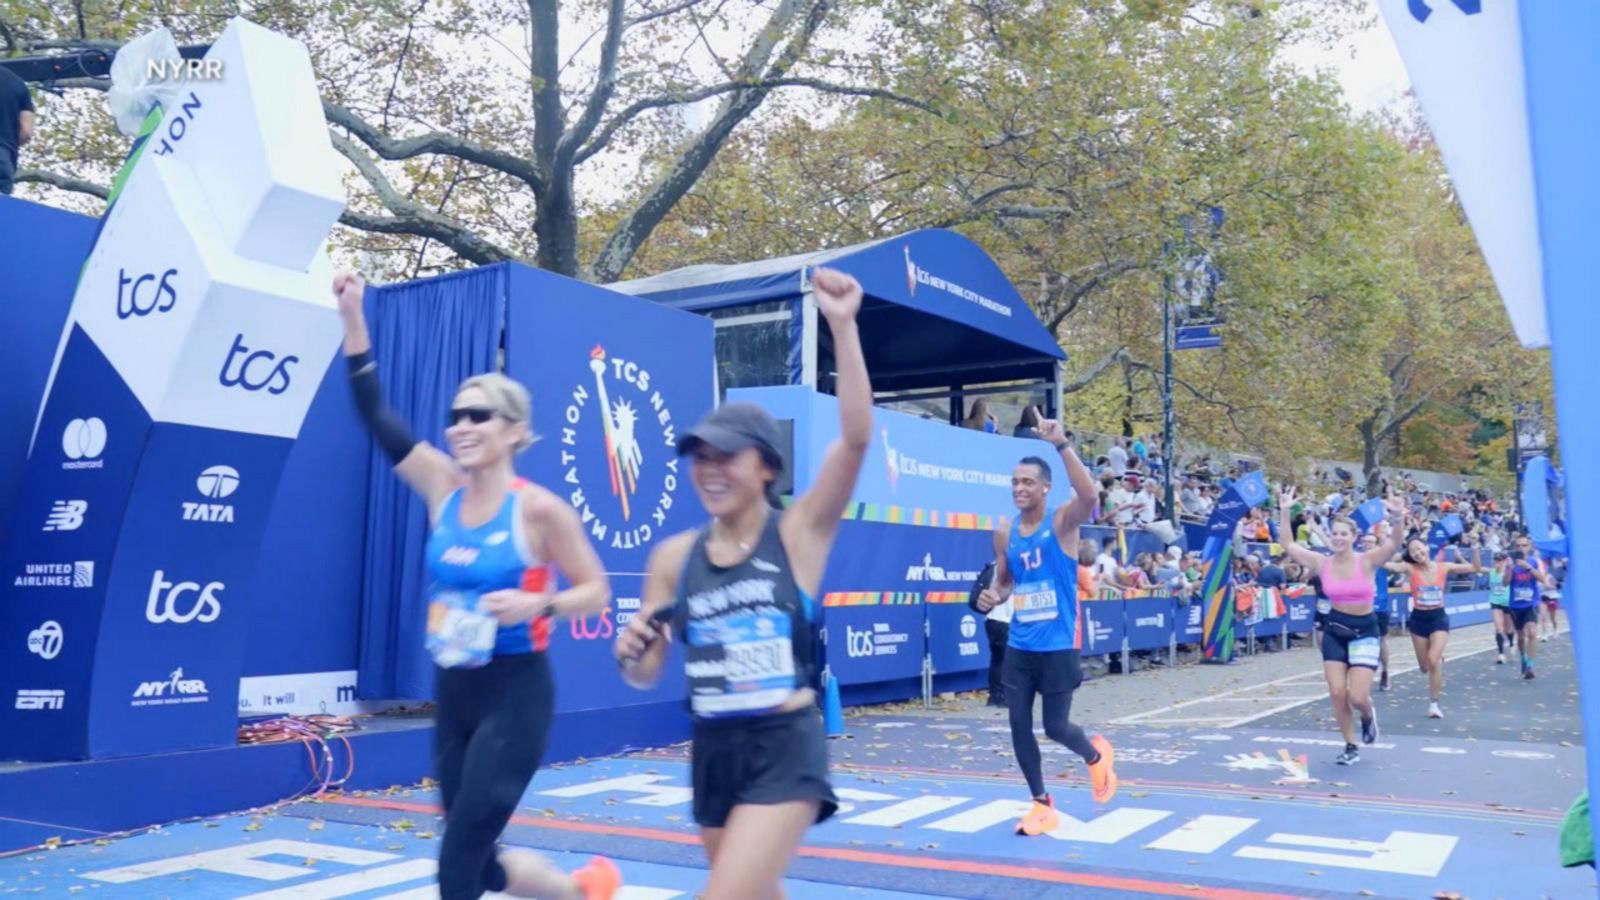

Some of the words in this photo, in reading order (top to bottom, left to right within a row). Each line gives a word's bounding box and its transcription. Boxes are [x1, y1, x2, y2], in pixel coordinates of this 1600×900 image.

[153, 91, 202, 156] HON
[116, 268, 178, 320] tcs
[930, 276, 946, 291] NEW
[219, 333, 299, 395] tcs
[611, 358, 650, 392] TCS
[650, 391, 677, 448] NEW
[62, 460, 104, 469] mastercard
[561, 384, 606, 541] MARATHON
[918, 463, 940, 480] NEW
[941, 467, 965, 483] YORK
[965, 470, 985, 485] CITY
[985, 472, 1013, 488] MARAT
[651, 458, 679, 527] YORK
[182, 502, 235, 523] TATA
[610, 524, 652, 550] CITY
[26, 563, 72, 575] UNITED
[1020, 547, 1042, 571] TJ
[14, 575, 72, 587] AIRLINES
[146, 569, 225, 624] tcs
[846, 624, 874, 658] tcs
[15, 689, 65, 709] ESPN
[133, 678, 209, 698] NYRR
[336, 685, 356, 703] m
